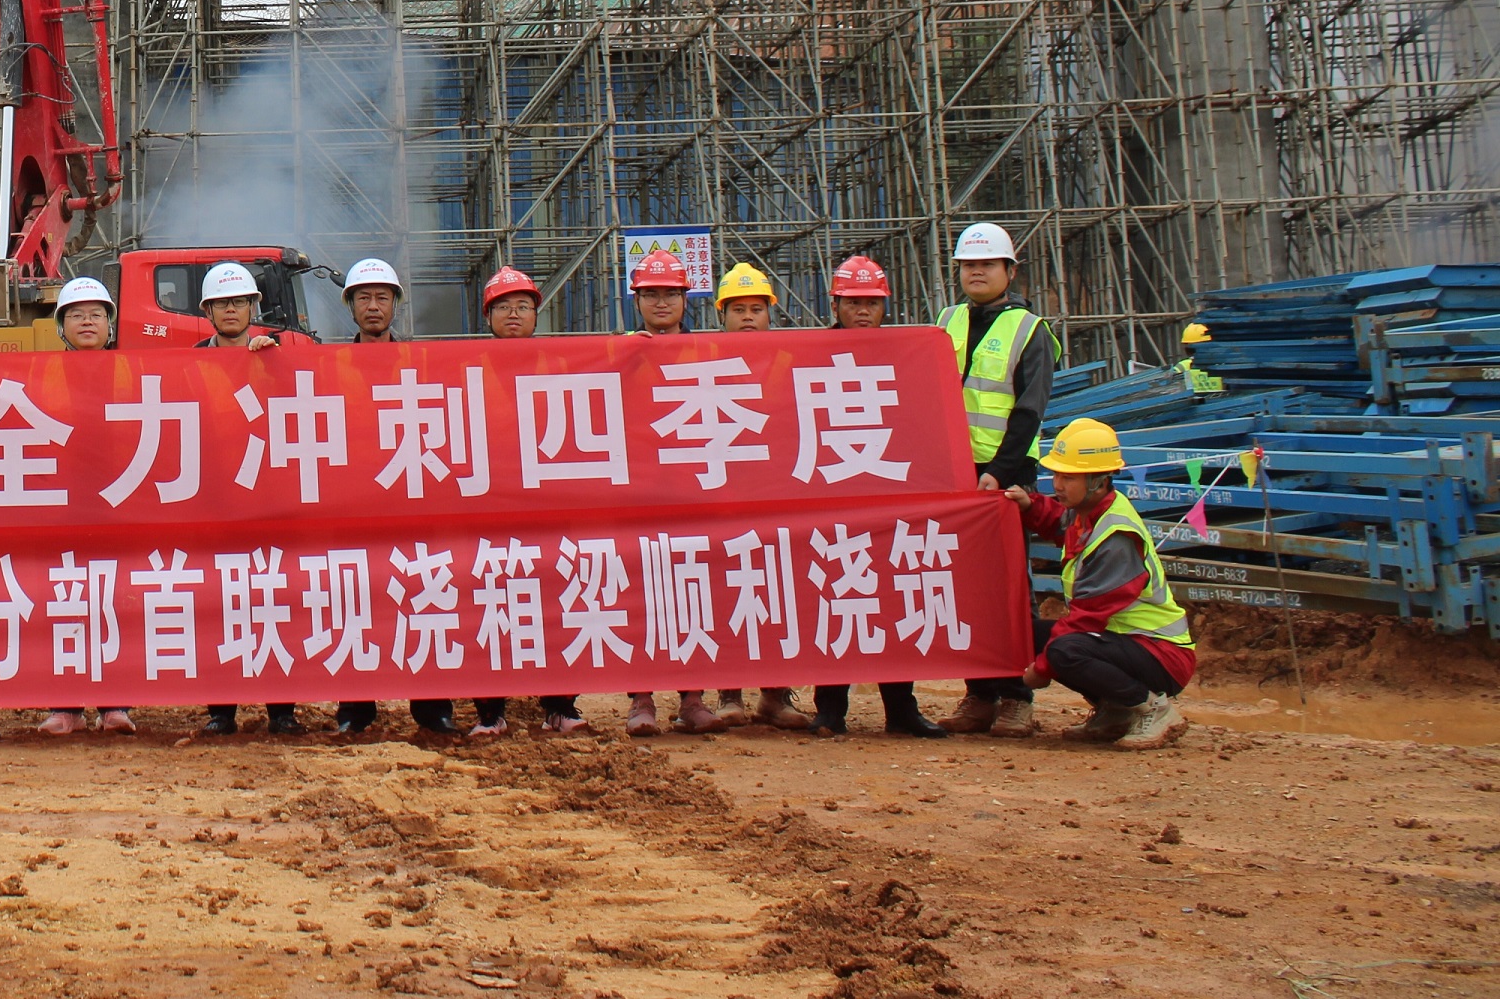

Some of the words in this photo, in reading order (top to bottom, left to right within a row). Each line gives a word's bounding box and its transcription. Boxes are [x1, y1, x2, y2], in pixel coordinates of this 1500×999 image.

[698, 236, 710, 289] 注意安全
[142, 323, 167, 338] 玉溪
